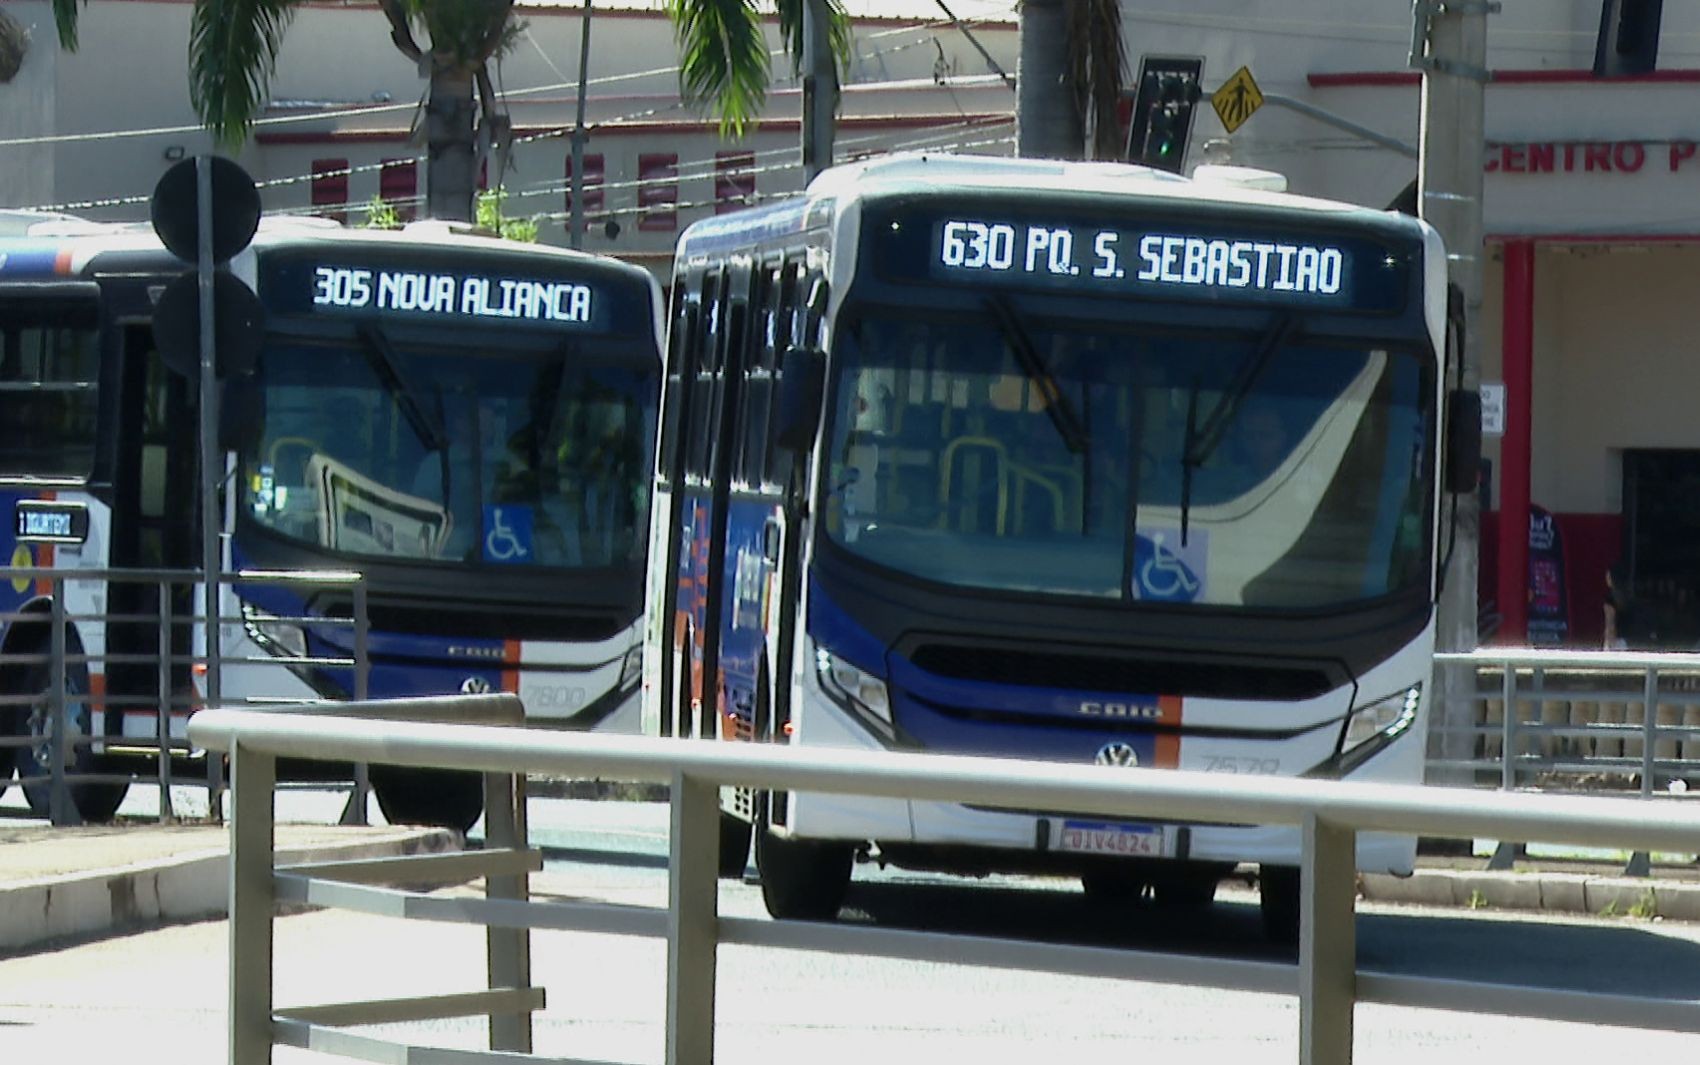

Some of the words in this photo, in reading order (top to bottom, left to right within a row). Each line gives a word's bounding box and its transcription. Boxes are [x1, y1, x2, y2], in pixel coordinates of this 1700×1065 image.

[942, 220, 1015, 270] 630
[1025, 227, 1080, 276] PQ.
[1093, 231, 1125, 279] S.
[1138, 235, 1342, 294] SEBASTIAO
[313, 267, 371, 306] 305
[378, 272, 454, 312] NOVA
[462, 279, 591, 322] ALIANCA
